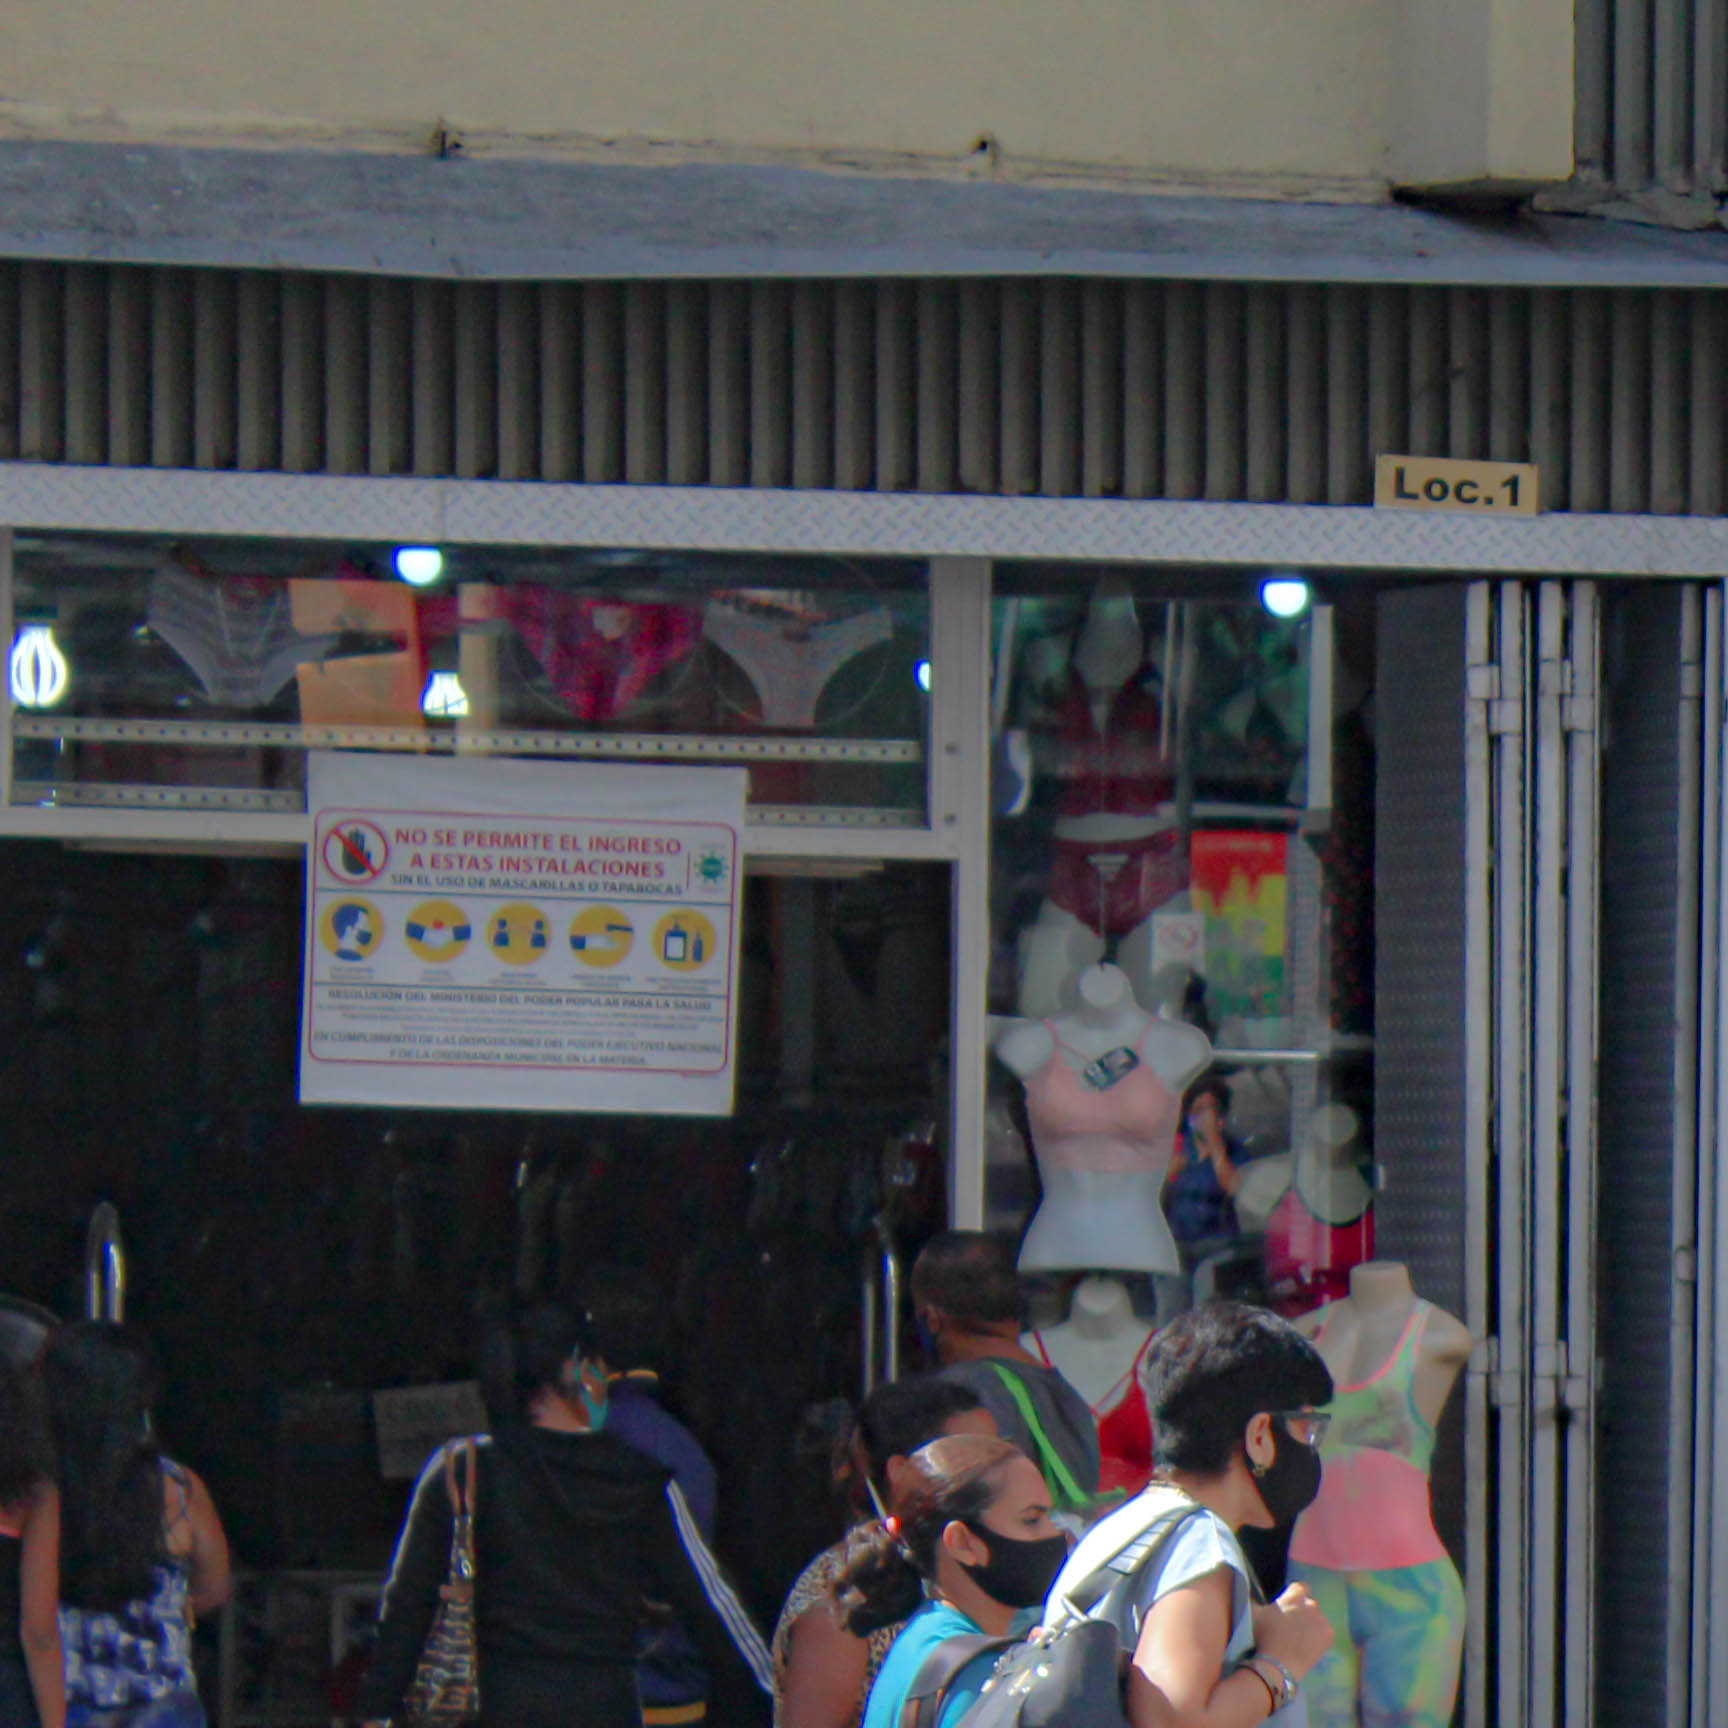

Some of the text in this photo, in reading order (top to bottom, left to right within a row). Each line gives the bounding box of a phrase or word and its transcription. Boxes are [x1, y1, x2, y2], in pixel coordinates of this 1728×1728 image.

[1394, 465, 1521, 507] Loc.1
[395, 828, 428, 847] NO
[433, 829, 457, 848] SE
[463, 831, 552, 850] PERMITE
[560, 834, 583, 852] EL
[589, 836, 682, 855] INGRESO
[410, 853, 666, 879] A ESTAS INSTALACIONES
[391, 873, 413, 885] SIN
[416, 874, 433, 887] EL
[436, 876, 464, 888] USO
[468, 877, 486, 888] DE
[603, 882, 682, 896] TAPABOCAS
